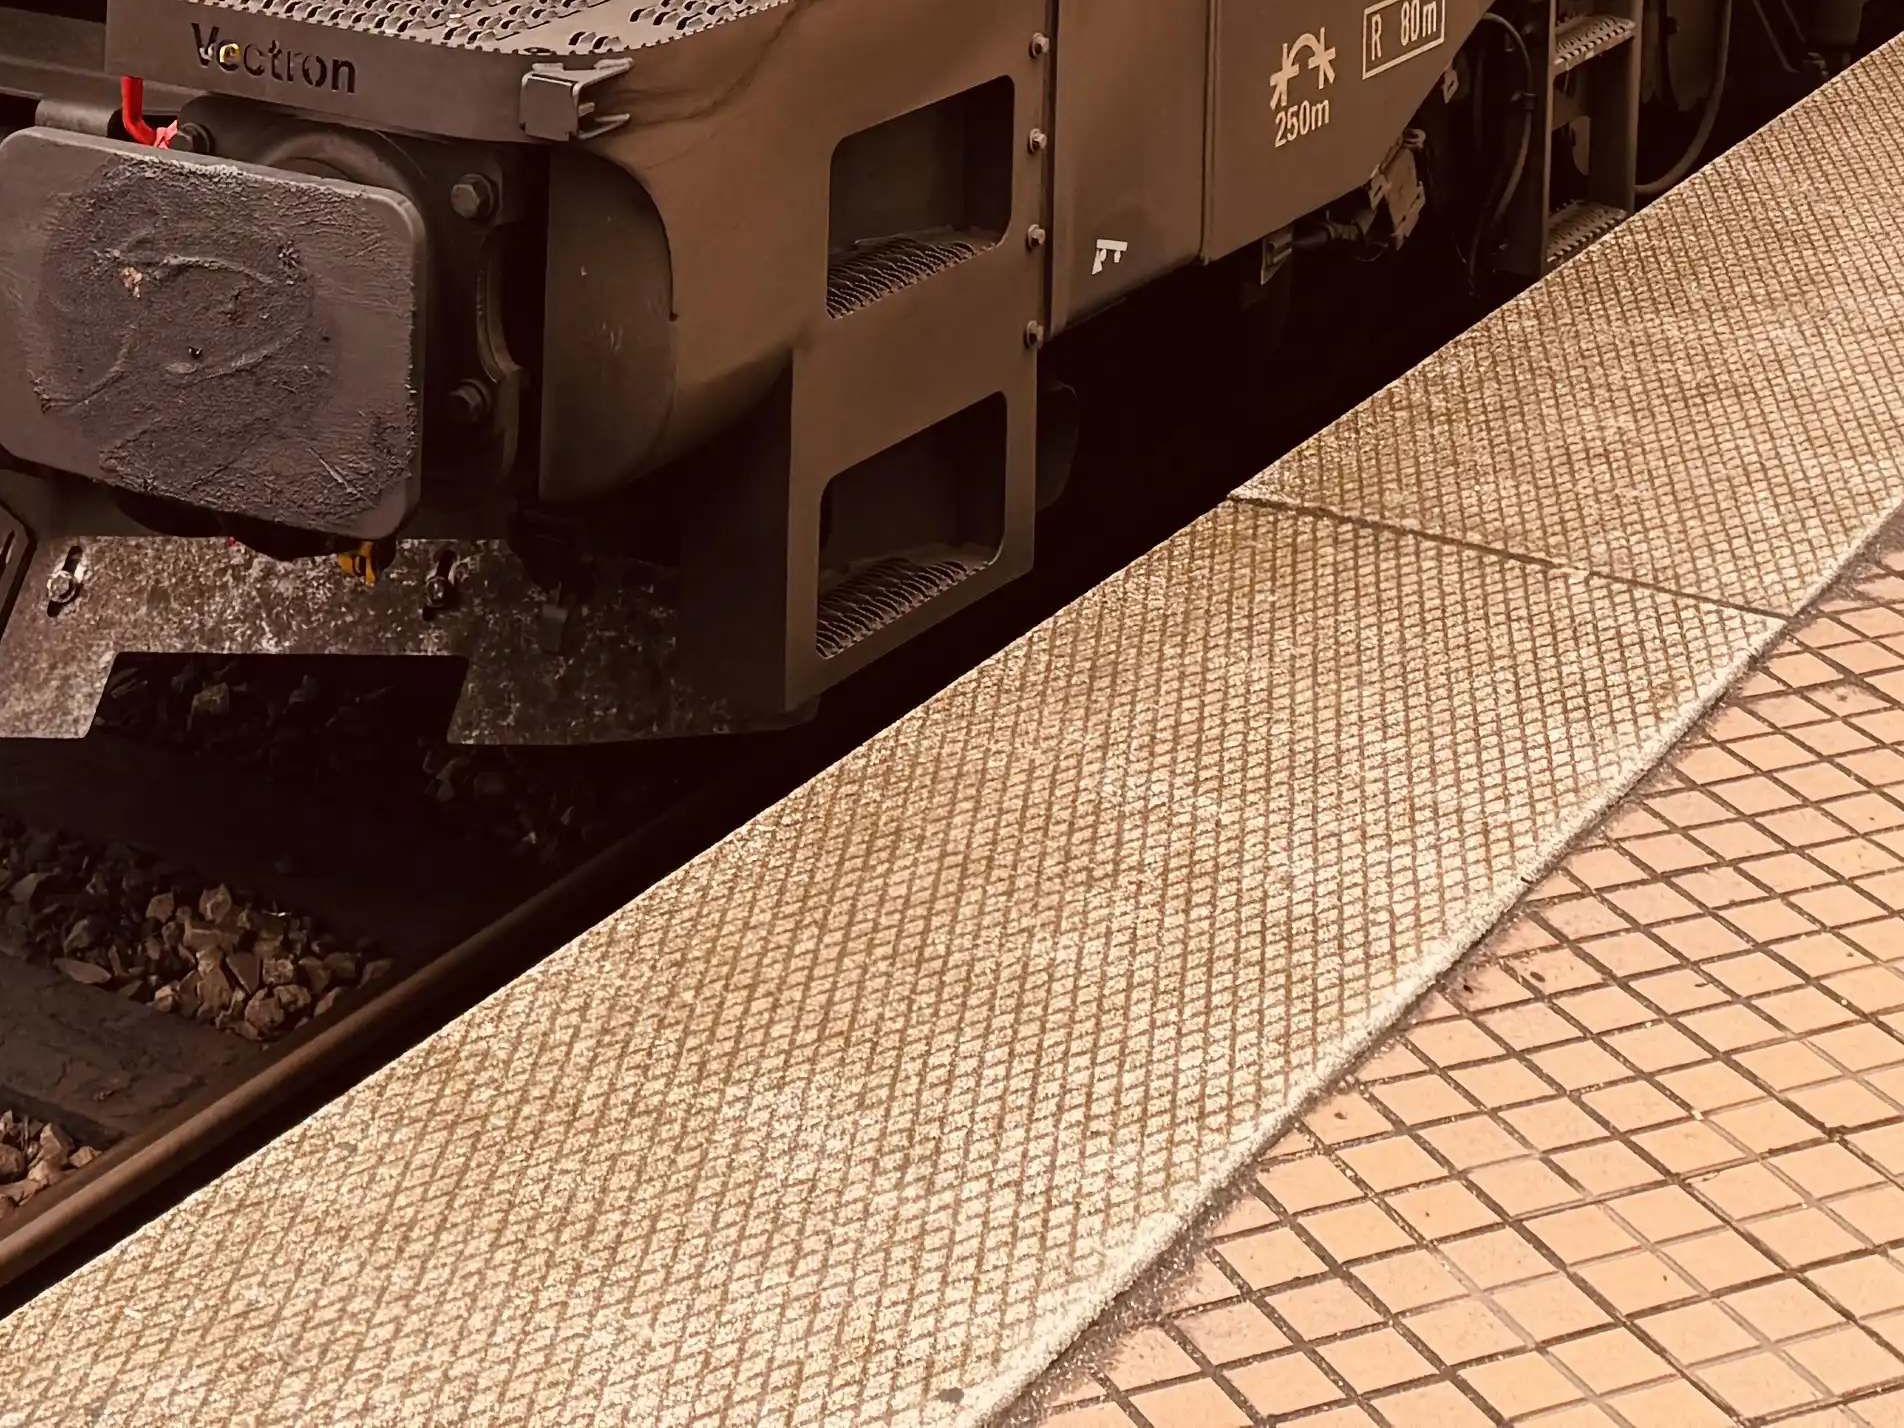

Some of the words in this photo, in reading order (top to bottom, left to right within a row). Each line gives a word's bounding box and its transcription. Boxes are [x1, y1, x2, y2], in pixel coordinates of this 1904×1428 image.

[191, 21, 357, 95] Vectron
[1371, 13, 1382, 61] R
[1274, 99, 1331, 149] 250m
